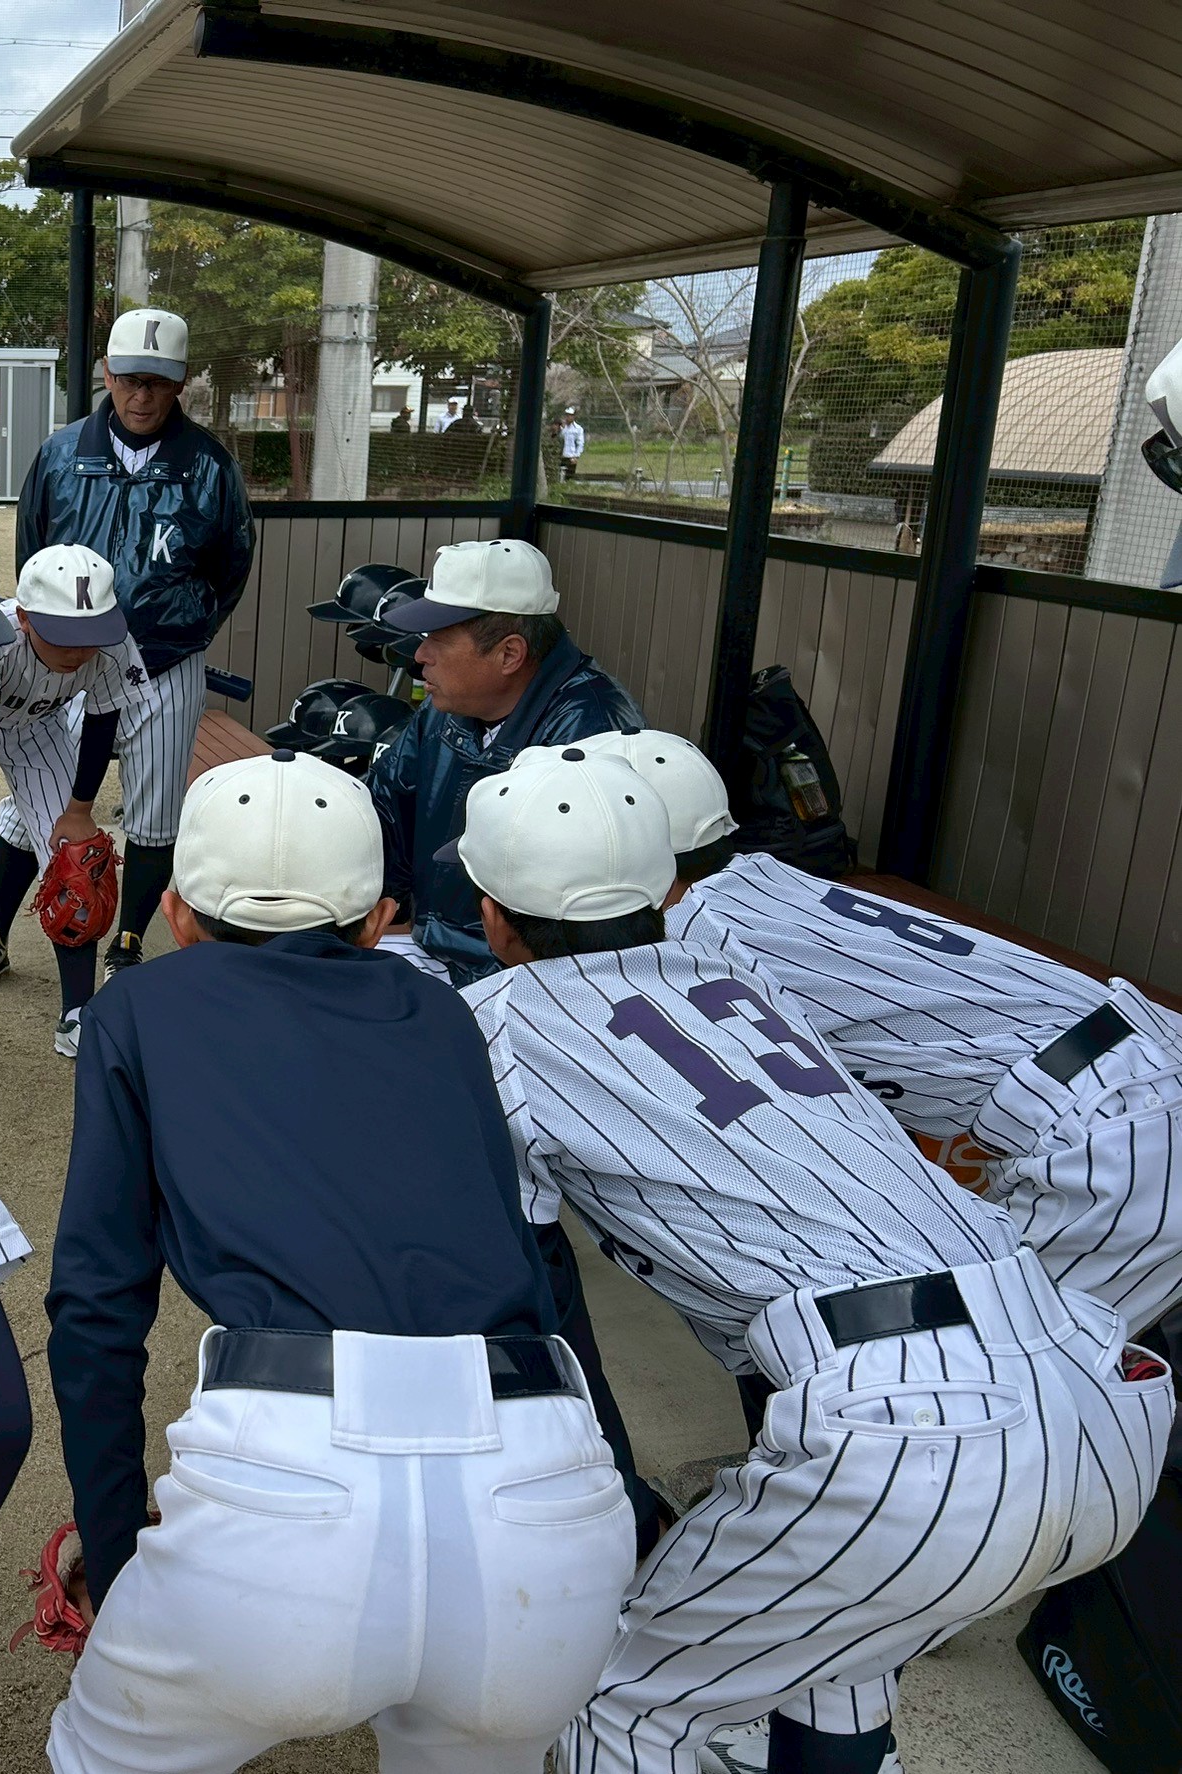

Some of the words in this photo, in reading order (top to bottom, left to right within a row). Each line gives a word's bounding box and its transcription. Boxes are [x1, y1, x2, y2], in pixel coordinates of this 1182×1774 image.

[144, 320, 160, 351] K
[152, 524, 175, 564] K
[76, 577, 93, 610] K
[373, 598, 388, 621] K
[289, 700, 302, 723] K
[332, 711, 352, 735] K
[372, 743, 390, 764] K
[820, 887, 976, 956] 8
[606, 978, 853, 1130] 13
